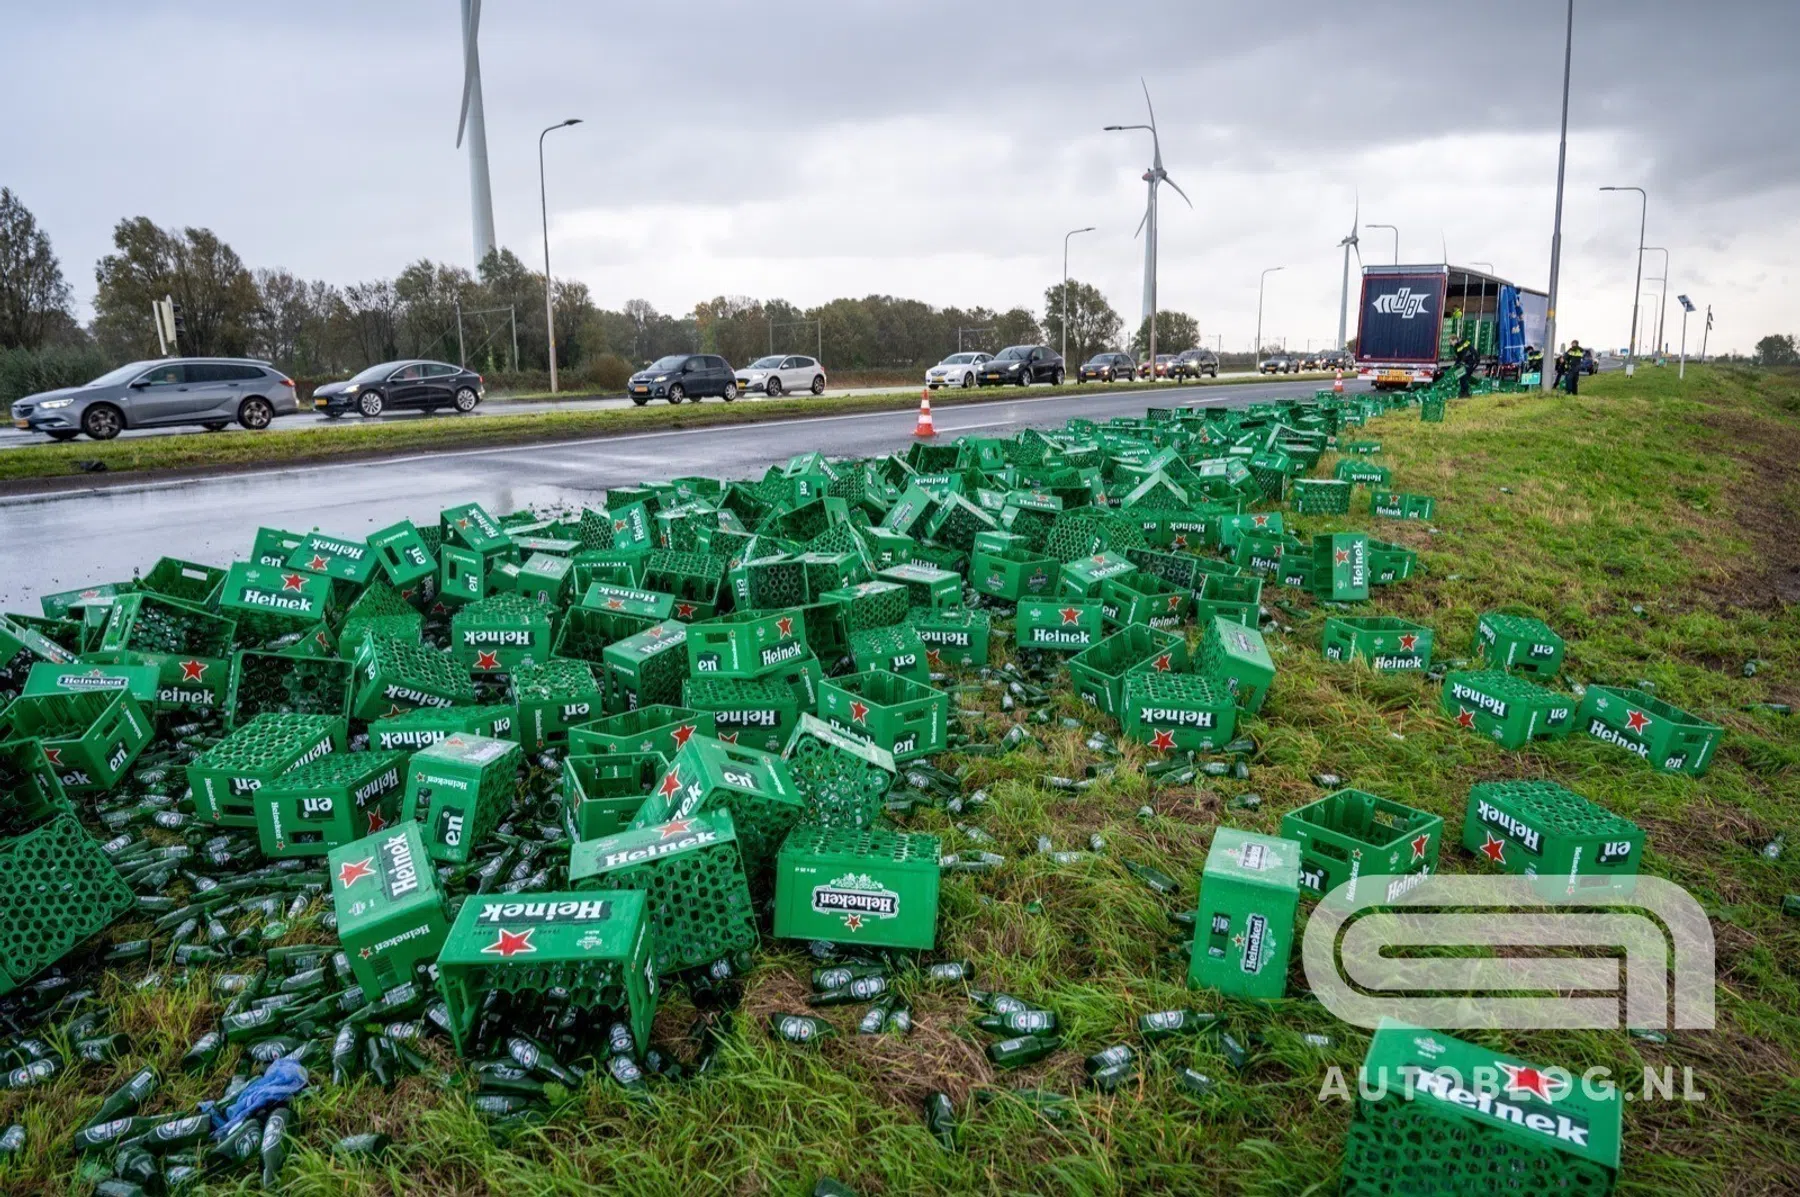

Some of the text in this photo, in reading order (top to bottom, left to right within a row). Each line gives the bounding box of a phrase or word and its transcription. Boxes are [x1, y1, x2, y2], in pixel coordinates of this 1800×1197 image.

[800, 481, 808, 496] en
[468, 508, 500, 538] Heinek
[628, 508, 644, 542] Heinek
[311, 538, 364, 560] Heinek
[260, 555, 282, 568] en
[1353, 540, 1363, 586] Heinek
[469, 576, 478, 592] en
[1285, 576, 1301, 586] en
[244, 590, 314, 612] Heinek
[598, 587, 656, 603] Heinek
[464, 631, 530, 645] Heinek
[1034, 628, 1091, 644] Heinek
[762, 642, 802, 667] Heinek
[1327, 646, 1340, 660] en
[1534, 644, 1554, 655] en
[698, 658, 717, 672] en
[894, 654, 916, 667] en
[1374, 656, 1422, 669] Heinek
[384, 684, 452, 709] Heinek
[1452, 684, 1507, 717] Heinek
[565, 702, 590, 716] en
[1141, 707, 1212, 728] Heinek
[1550, 708, 1568, 720] en
[494, 717, 511, 732] en
[380, 730, 446, 748] Heinek
[894, 737, 915, 755] en
[1590, 719, 1650, 760] Heinek
[110, 748, 128, 772] en
[1665, 756, 1682, 768] en
[236, 778, 262, 792] en
[355, 768, 400, 806] Heinek
[426, 776, 467, 790] Heineken
[724, 772, 753, 788] en
[304, 798, 333, 812] en
[446, 816, 464, 846] en
[1478, 800, 1540, 851] Heinek
[605, 831, 716, 867] Heinek
[1604, 840, 1631, 856] en
[384, 833, 418, 897] Heinek
[1386, 864, 1430, 903] Heinek
[480, 900, 603, 922] Heinek
[819, 892, 892, 912] Heineken
[374, 924, 430, 954] Heineken
[1245, 919, 1264, 971] Heineken
[1414, 1066, 1590, 1147] Heinek
